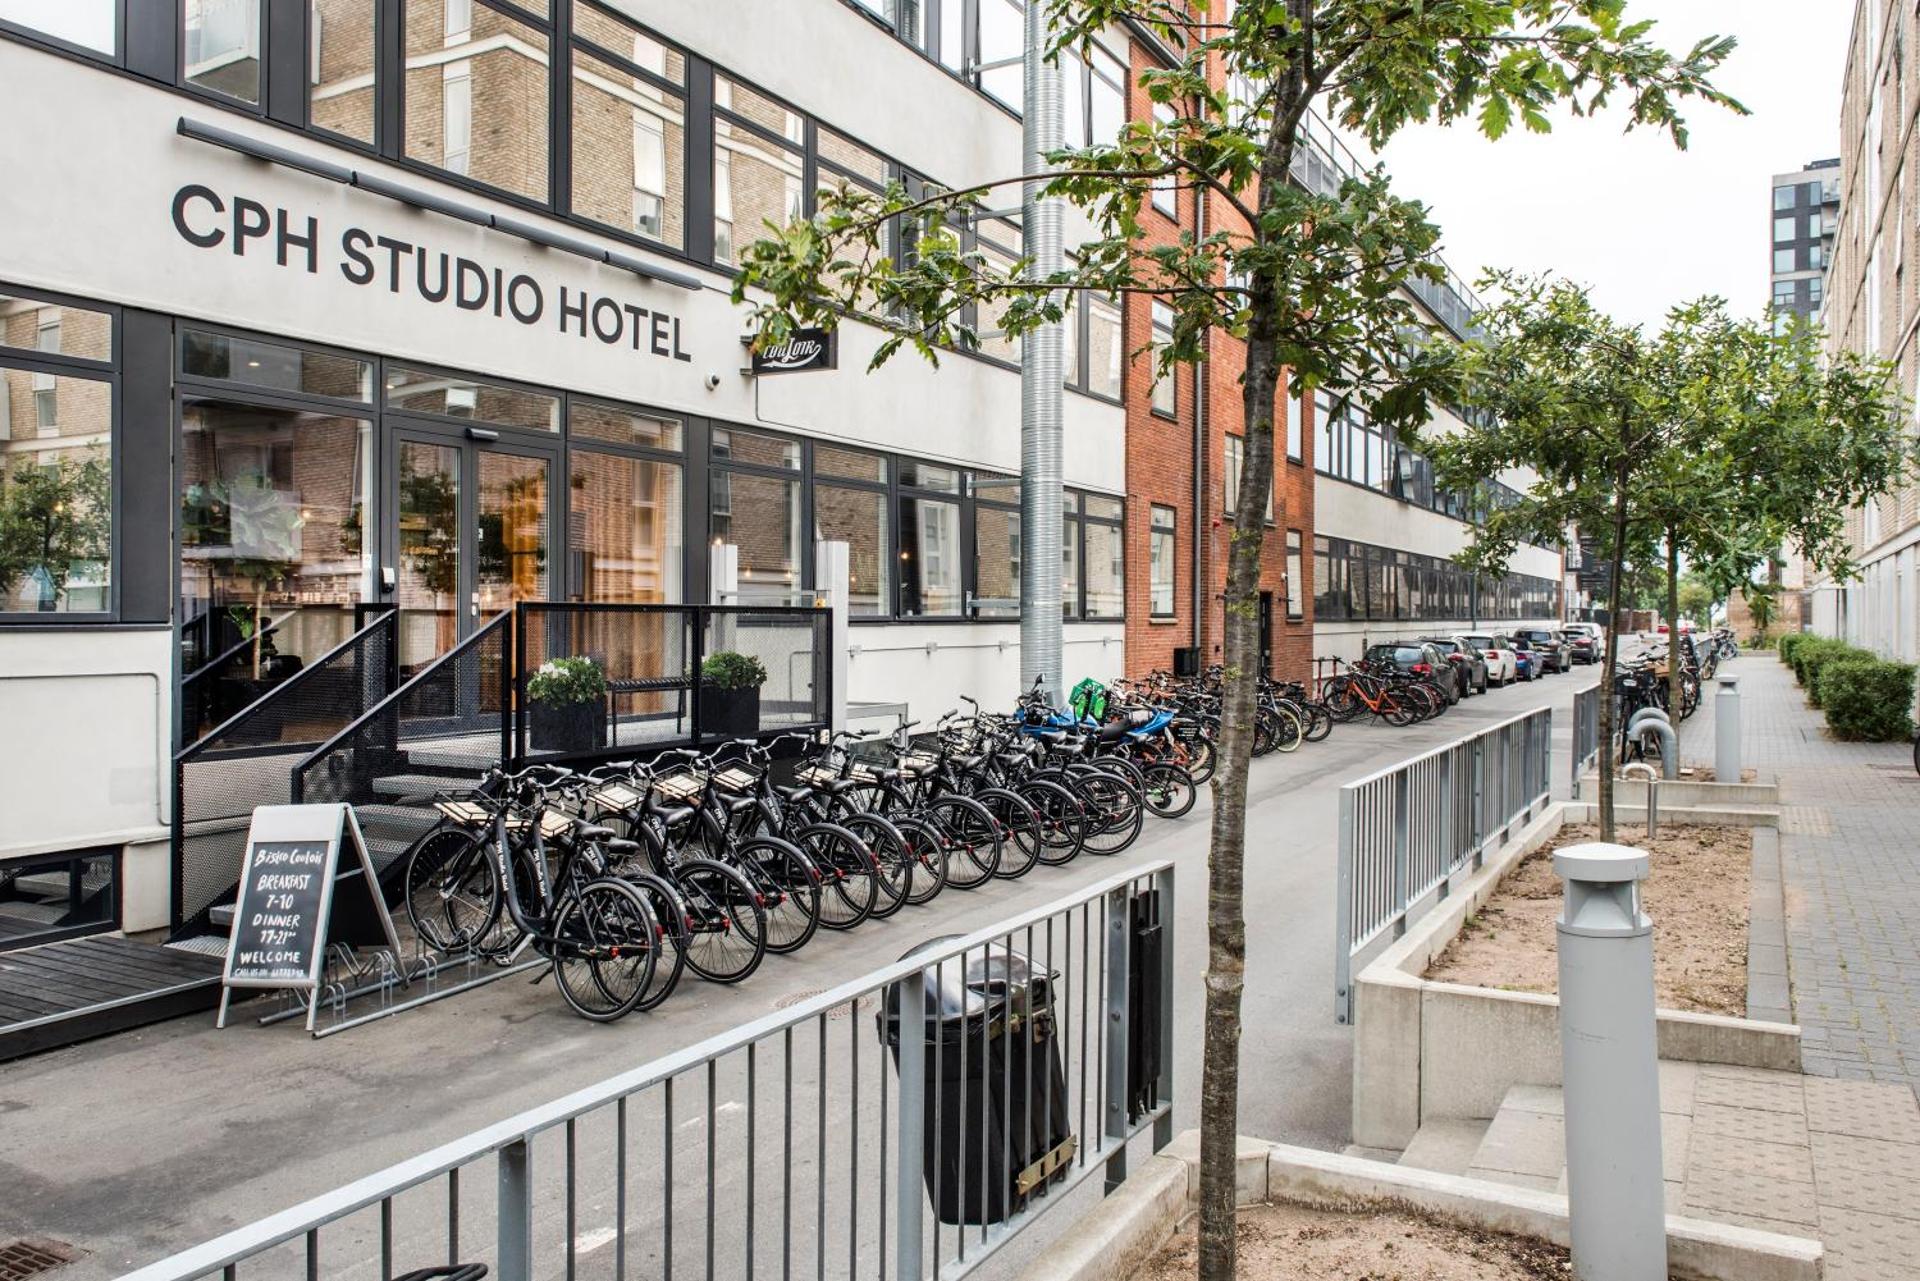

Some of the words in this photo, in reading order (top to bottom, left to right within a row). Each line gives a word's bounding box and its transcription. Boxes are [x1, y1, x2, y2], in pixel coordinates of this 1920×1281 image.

[172, 184, 318, 274] CPH
[340, 228, 544, 325] STUDIO
[559, 285, 692, 363] HOTEL
[256, 874, 312, 891] BREAKFAST
[266, 894, 294, 909] 7-10
[252, 913, 301, 929] DINNER
[240, 951, 301, 964] WELCOME
